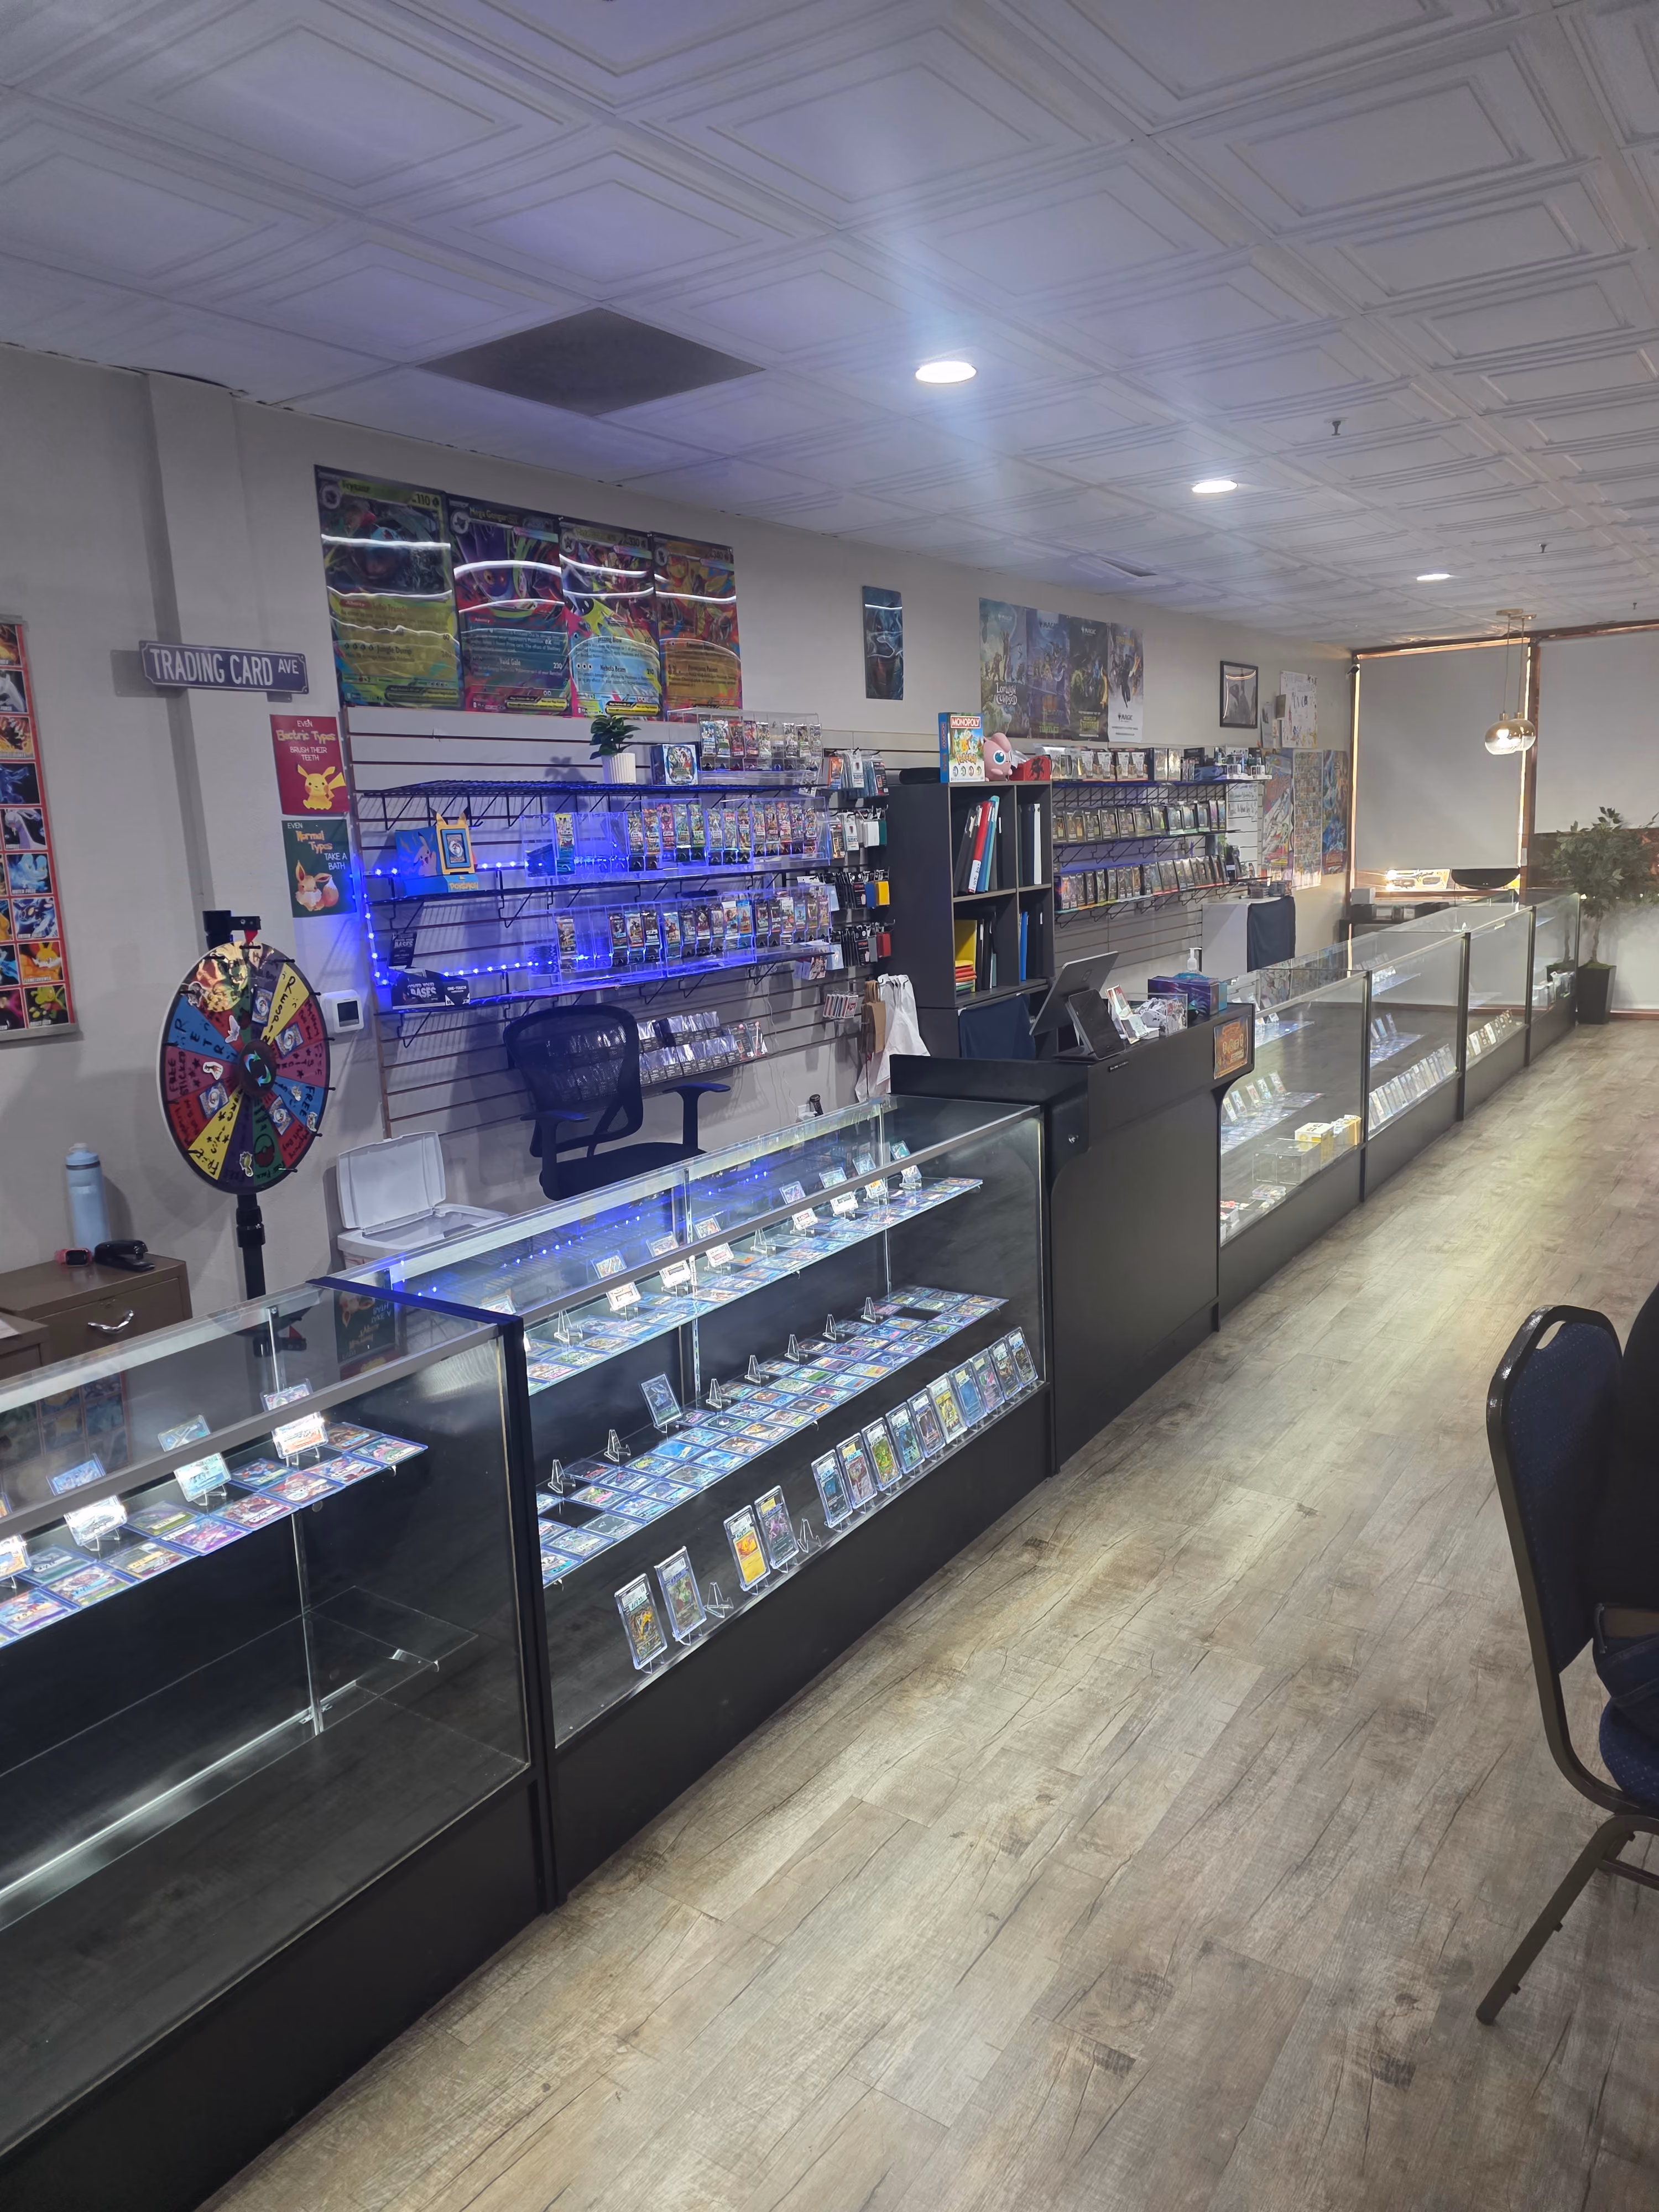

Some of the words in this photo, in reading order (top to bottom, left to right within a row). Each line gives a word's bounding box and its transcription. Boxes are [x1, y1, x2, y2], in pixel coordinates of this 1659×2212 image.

[414, 493, 430, 505] 110
[150, 648, 225, 683] TRADING
[229, 655, 273, 686] CARD
[278, 659, 299, 674] AVE
[951, 718, 980, 727] MONOPOLY
[311, 731, 336, 744] Types
[308, 841, 333, 854] Types
[328, 862, 346, 870] BATH
[410, 987, 437, 999] BASES
[300, 1085, 316, 1117] FREE
